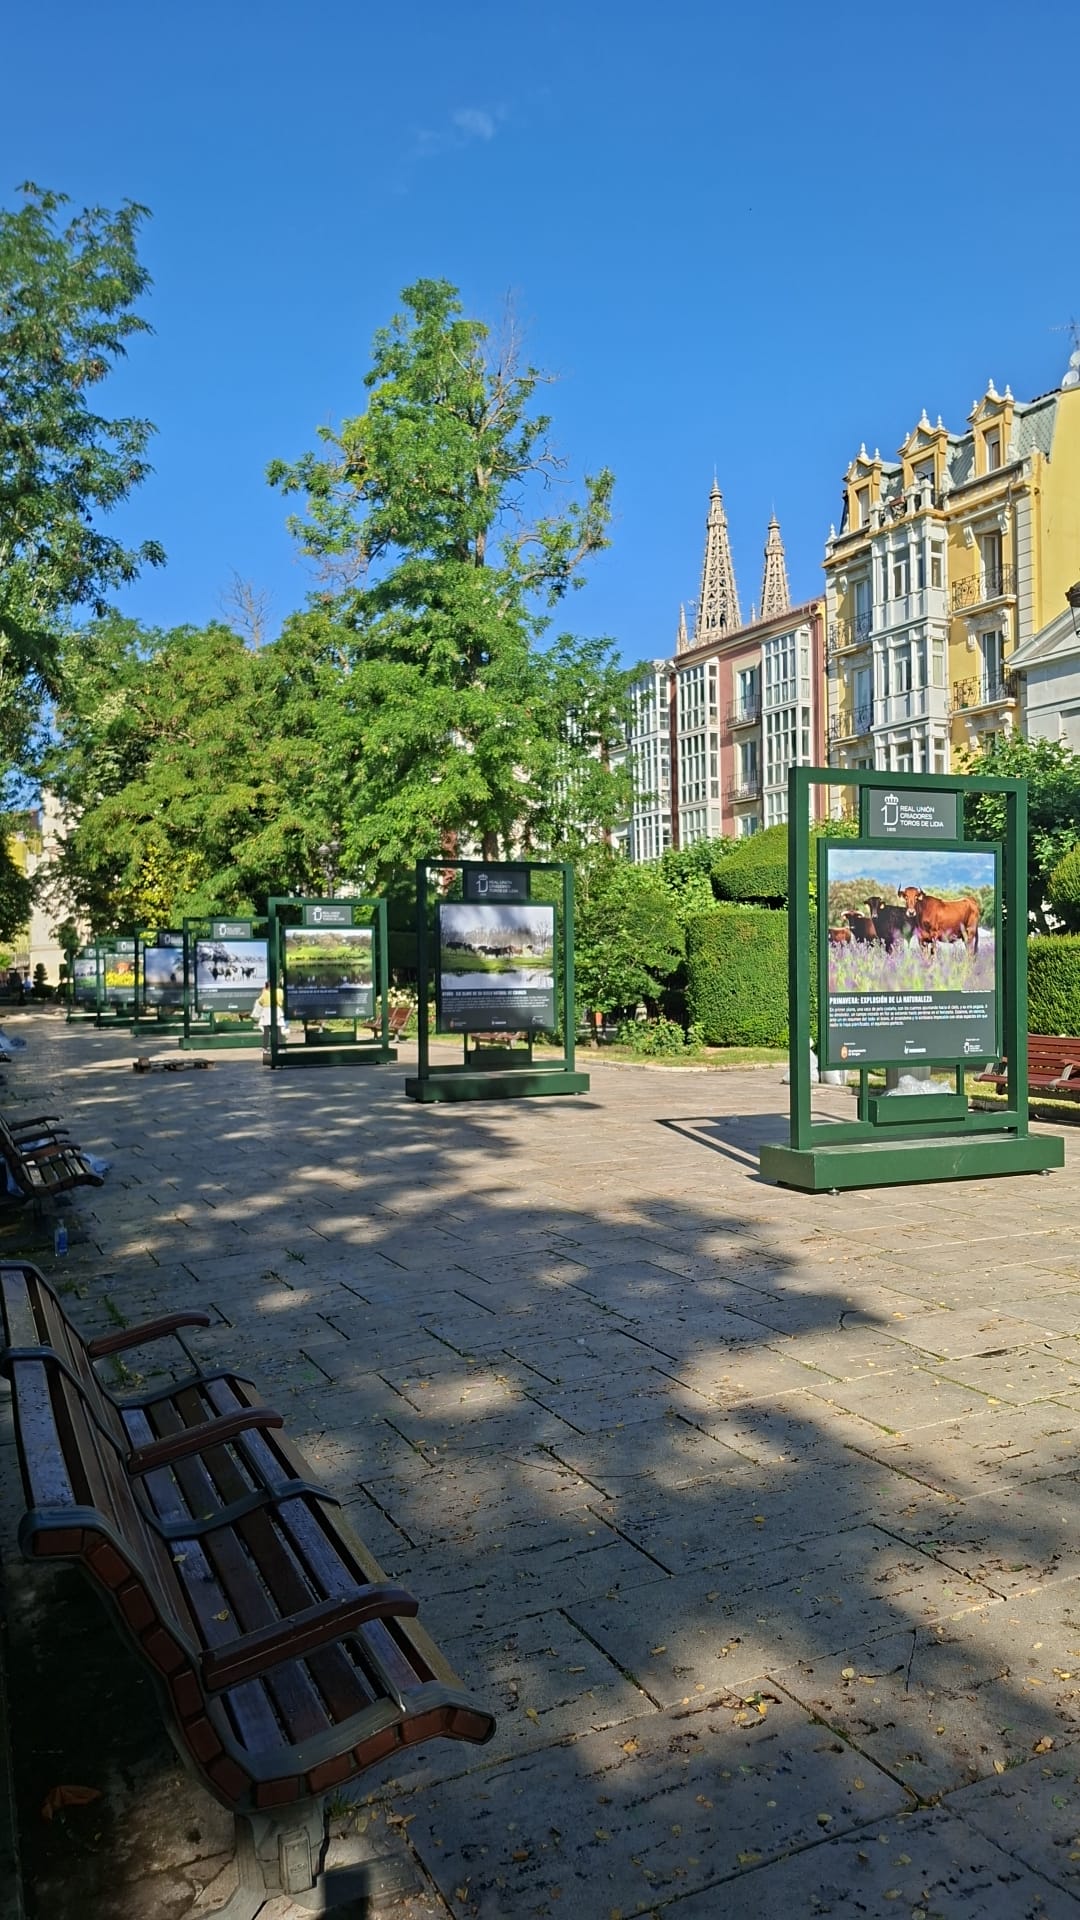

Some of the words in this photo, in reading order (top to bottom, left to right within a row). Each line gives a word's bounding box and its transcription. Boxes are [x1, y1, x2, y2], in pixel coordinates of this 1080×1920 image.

[829, 996, 860, 1005] PRIMAVERA:
[860, 995, 888, 1004] EXPLOSIÓN
[888, 996, 895, 1004] DE
[896, 995, 902, 1004] LA
[903, 995, 933, 1004] NATURALEZA
